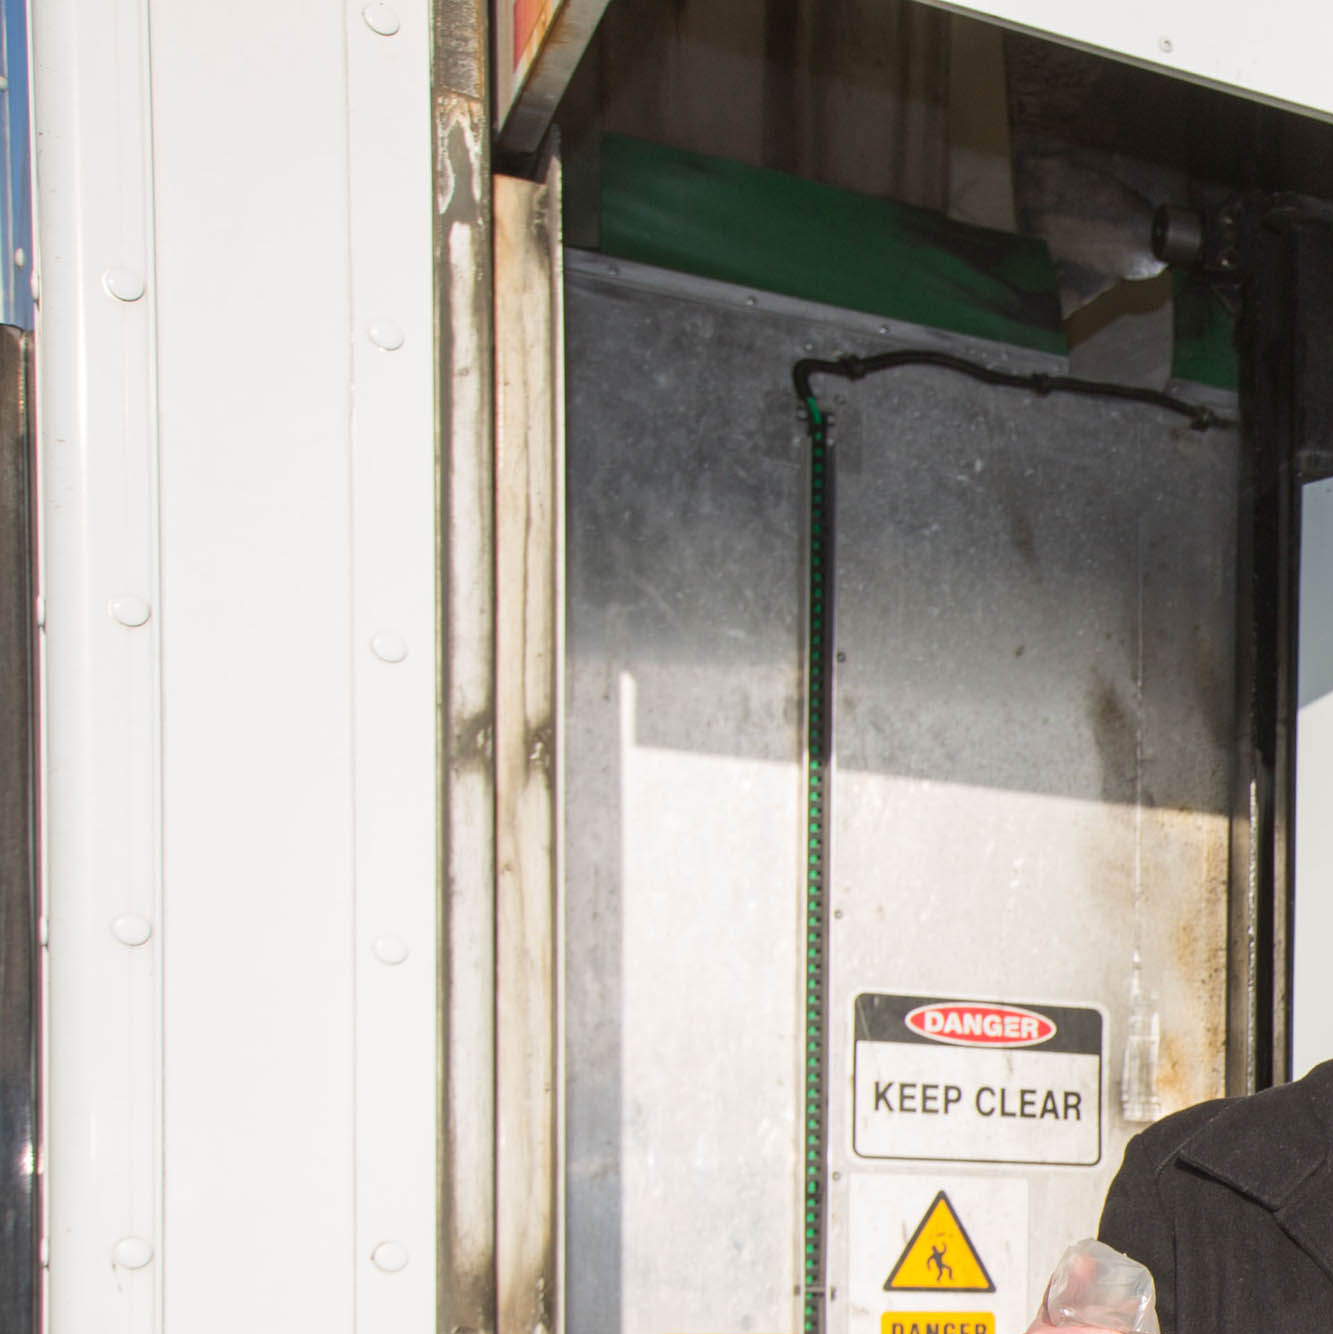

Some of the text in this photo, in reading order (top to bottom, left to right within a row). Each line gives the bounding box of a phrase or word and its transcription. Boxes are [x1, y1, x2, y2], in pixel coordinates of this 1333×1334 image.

[924, 1010, 1040, 1039] DANGER
[874, 1081, 1082, 1121] KEEP CLEAR
